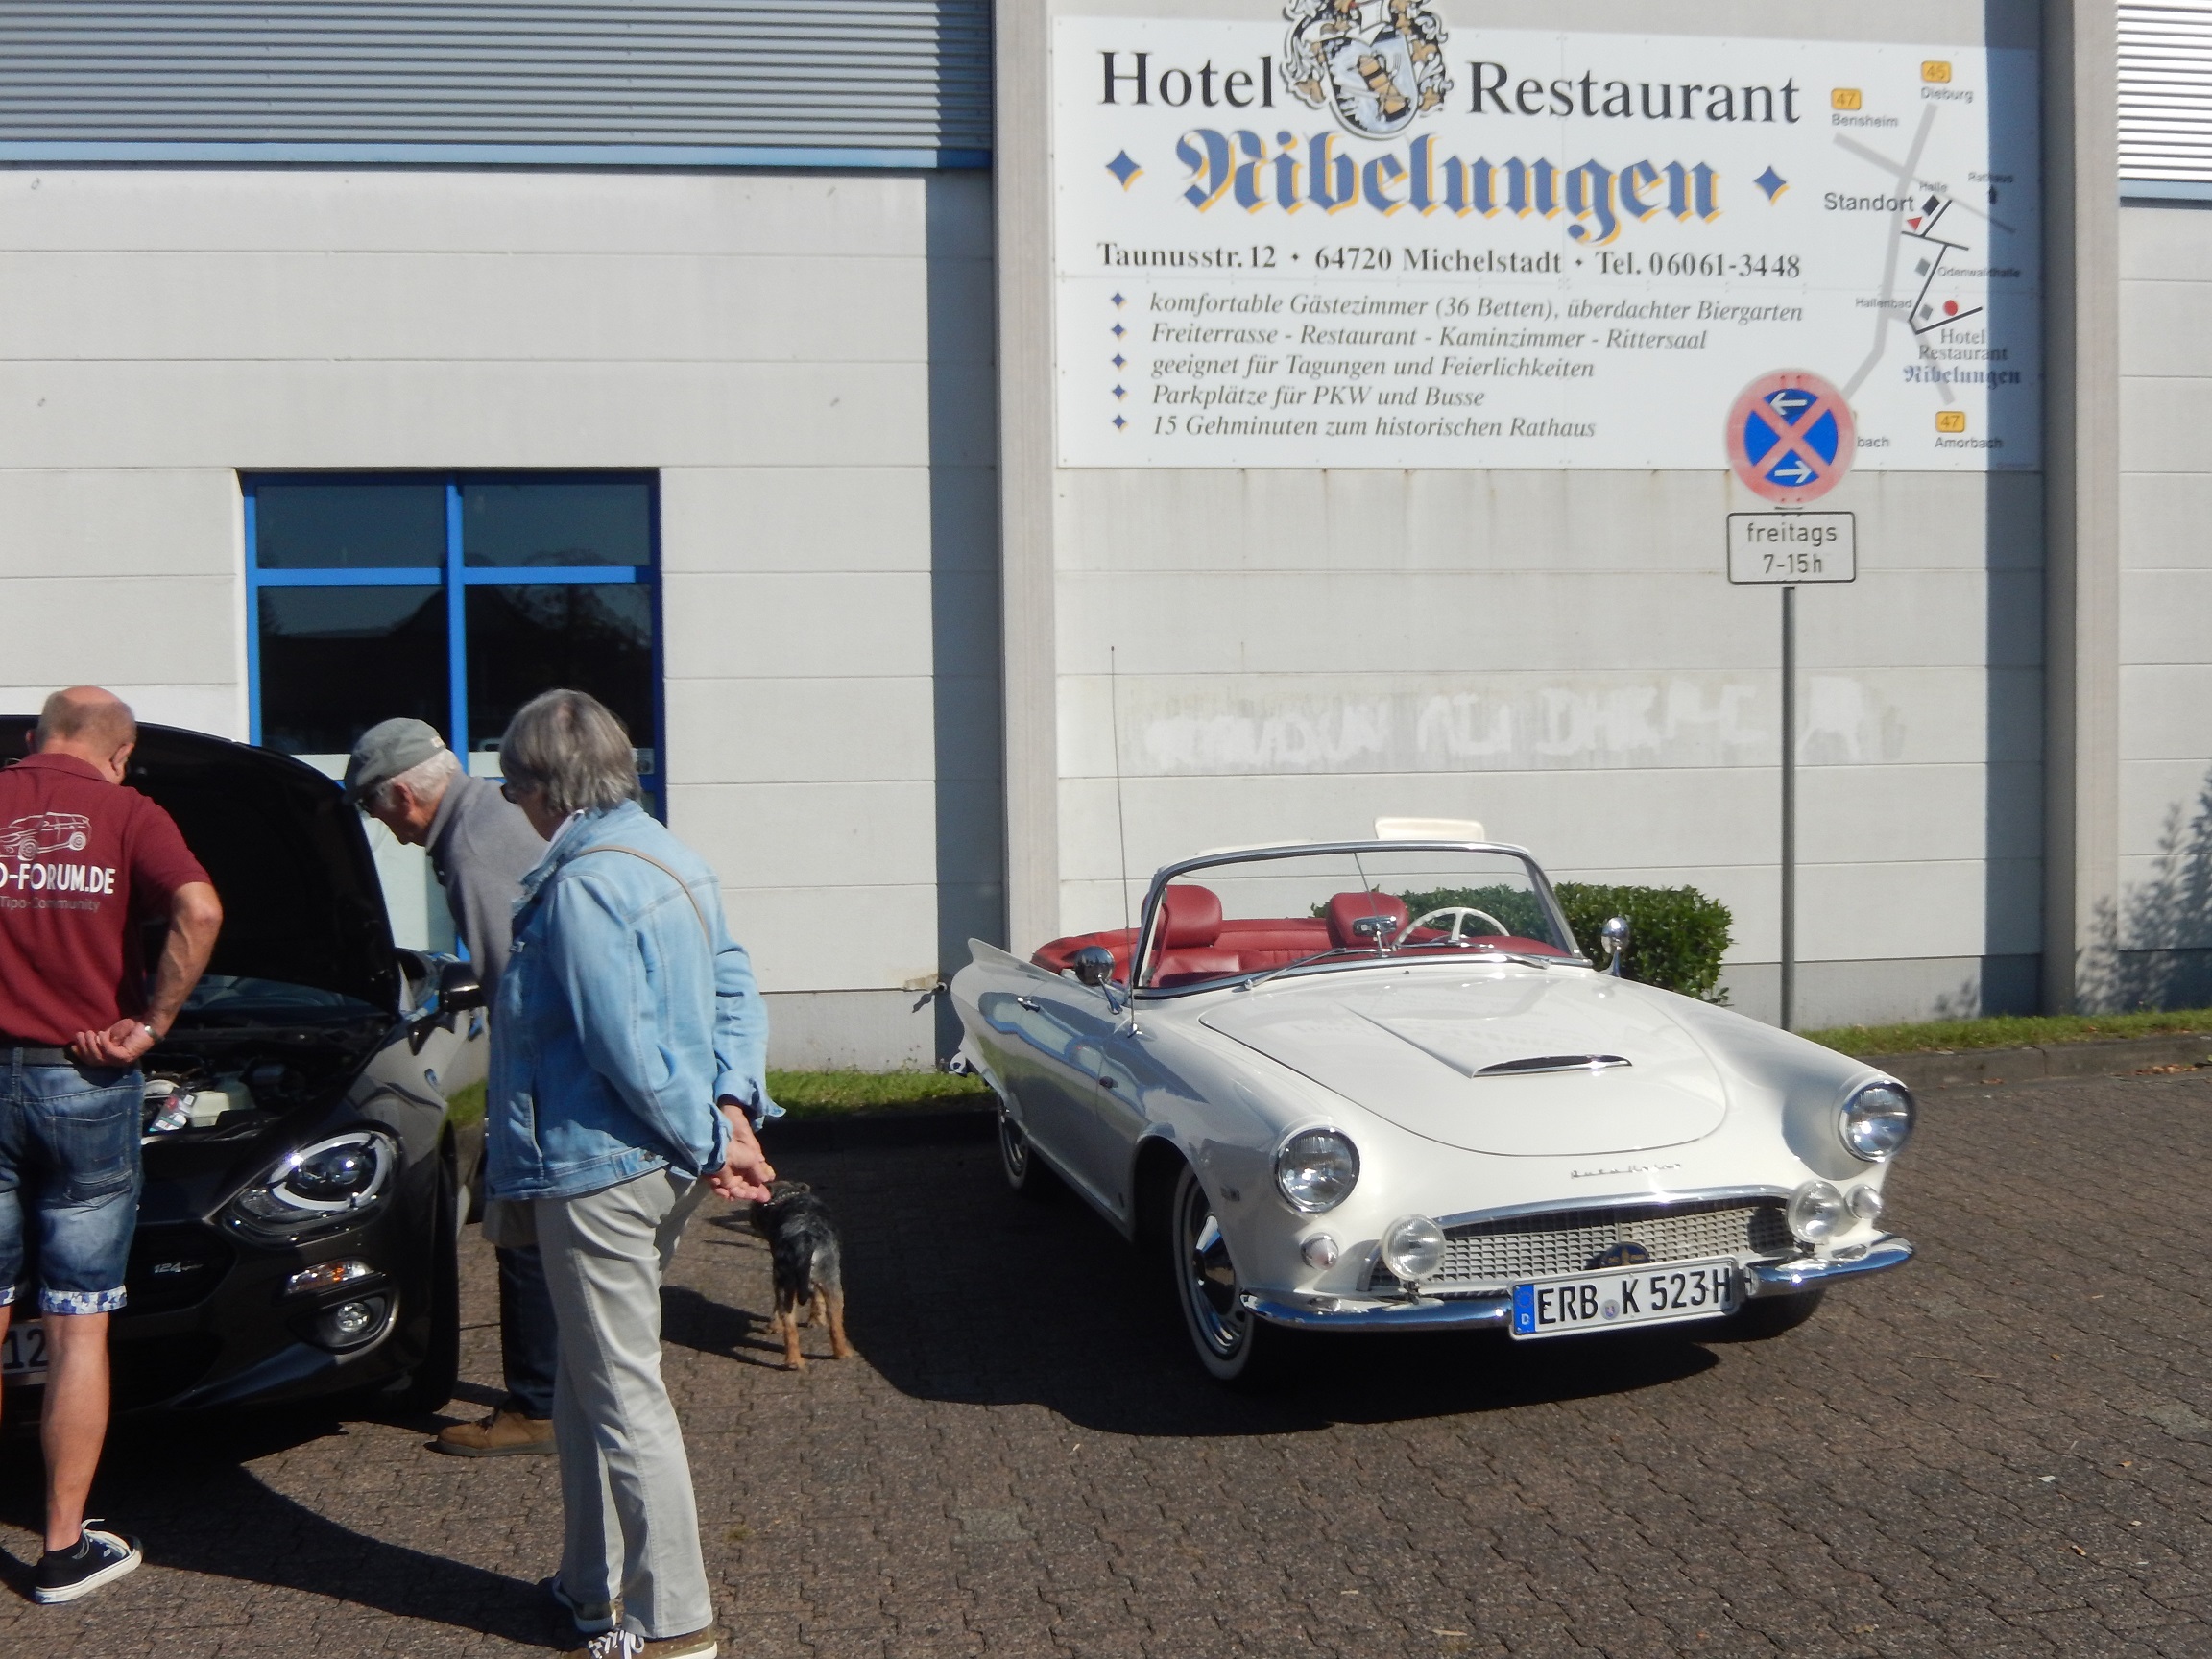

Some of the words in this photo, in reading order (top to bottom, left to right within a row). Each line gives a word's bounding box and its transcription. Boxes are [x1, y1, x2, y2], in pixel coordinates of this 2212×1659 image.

[1097, 50, 1274, 108] Hotel
[1466, 60, 1801, 124] Restaurant
[1920, 86, 1974, 103] Dieburg
[1831, 113, 1899, 128] Bensheim
[1175, 127, 1726, 247] Nibelungen
[1823, 192, 1915, 212] Standort
[1315, 246, 1393, 271] 64720
[1403, 248, 1562, 275] Michelstadt
[1596, 251, 1642, 276] Tel.
[1649, 252, 1802, 278] 06061-3448
[1150, 292, 1284, 317] komfortable
[1290, 293, 1430, 317] Gästezimmer
[1434, 296, 1471, 320] (36
[1477, 297, 1561, 323] Betten),
[1567, 300, 1691, 320] überdachter
[1695, 300, 1804, 325] Biergarten
[1855, 298, 1913, 309] Hallenbad
[1151, 323, 1279, 344] Freiterrasse
[1300, 324, 1417, 346] Restaurant
[1438, 326, 1586, 349] Kaminzimmer
[1606, 328, 1708, 349] Rittersaal
[1939, 329, 1987, 345] Hotel
[1918, 344, 2008, 361] Restaurant
[1150, 354, 1239, 379] geeignet
[1242, 354, 1279, 379] für
[1286, 355, 1386, 380] Tagungen
[1393, 357, 1434, 375] und
[1441, 356, 1595, 378] Feierlichkeiten
[1902, 365, 2021, 390] Nibelungen
[1152, 384, 1268, 410] Parkplätze
[1269, 385, 1307, 410] für
[1312, 386, 1372, 405] PKW
[1377, 387, 1418, 407] und
[1425, 387, 1485, 407] Busse
[1154, 415, 1178, 435] 15
[1186, 414, 1318, 436] Gehminuten
[1325, 421, 1368, 436] zum
[1375, 417, 1503, 438] historischen
[1509, 418, 1596, 438] Rathaus
[1856, 436, 1890, 448] bach
[1935, 437, 2005, 449] Amorbach
[1746, 522, 1838, 547] freitags
[1763, 553, 1822, 575] 7-15h
[1537, 1283, 1599, 1325] ERB
[1622, 1278, 1640, 1314] K
[1650, 1266, 1730, 1311] 523H
